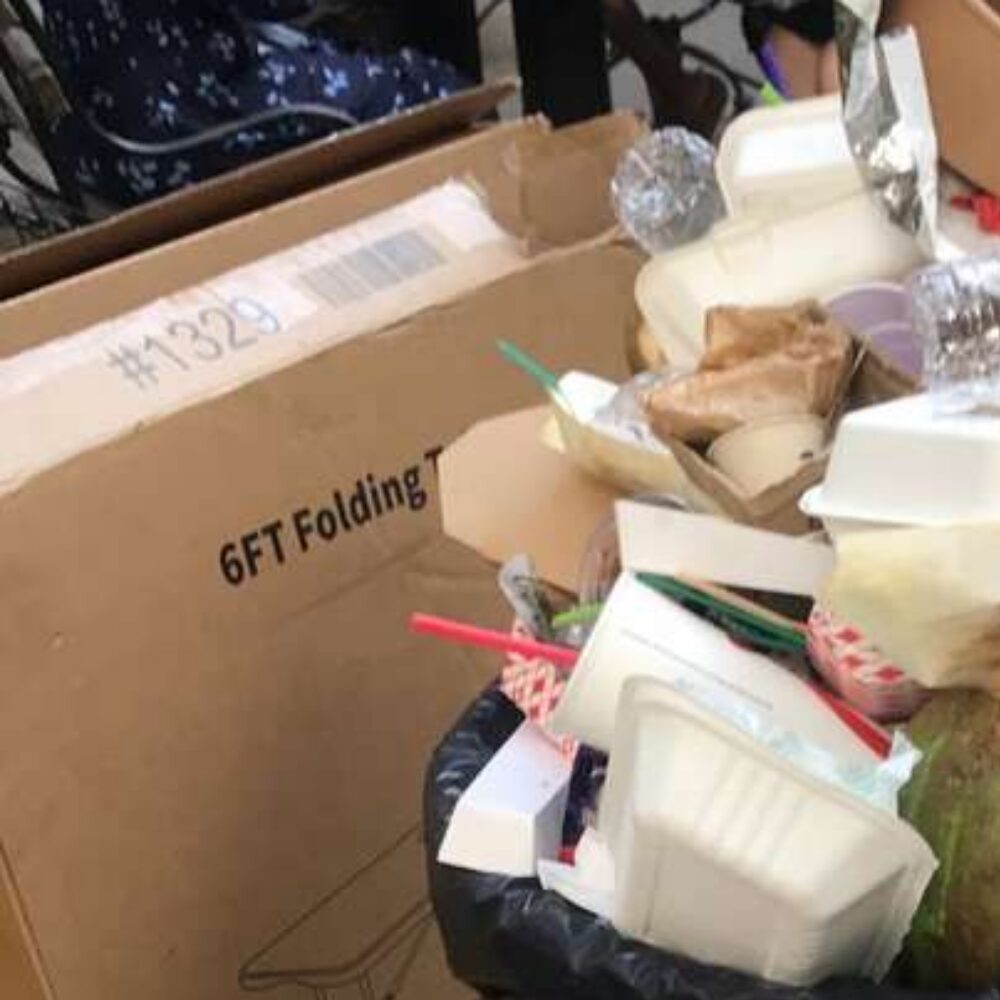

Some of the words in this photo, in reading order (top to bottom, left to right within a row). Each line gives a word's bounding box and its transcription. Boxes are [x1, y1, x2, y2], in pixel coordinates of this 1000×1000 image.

[104, 296, 281, 390] #1329
[219, 519, 286, 586] 6FT
[292, 465, 428, 553] Folding
